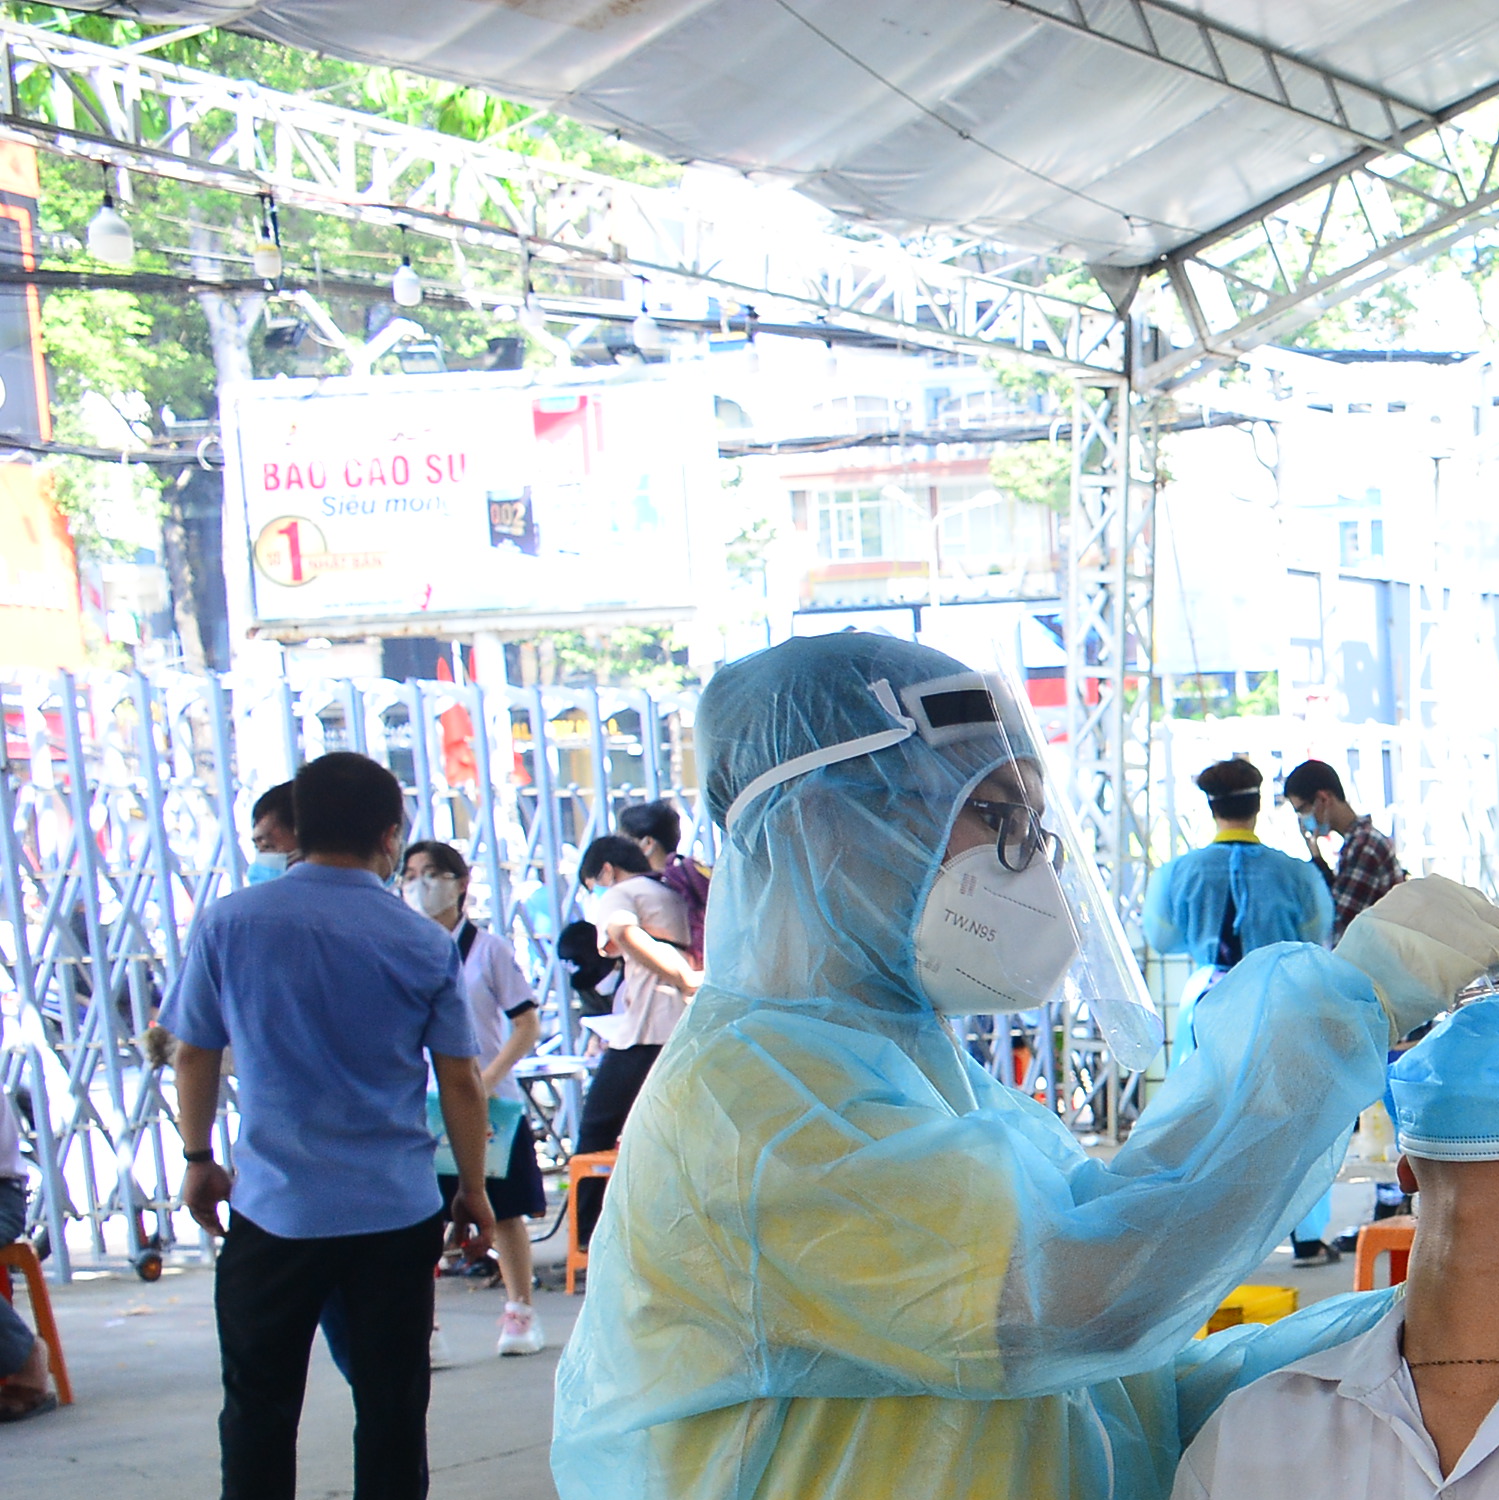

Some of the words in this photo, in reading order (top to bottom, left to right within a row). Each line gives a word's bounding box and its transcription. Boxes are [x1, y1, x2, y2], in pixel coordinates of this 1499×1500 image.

[264, 460, 326, 490] BAO
[344, 456, 410, 488] CAO
[426, 453, 466, 484] SU
[278, 522, 302, 582] 1
[944, 908, 998, 942] TW.N95
